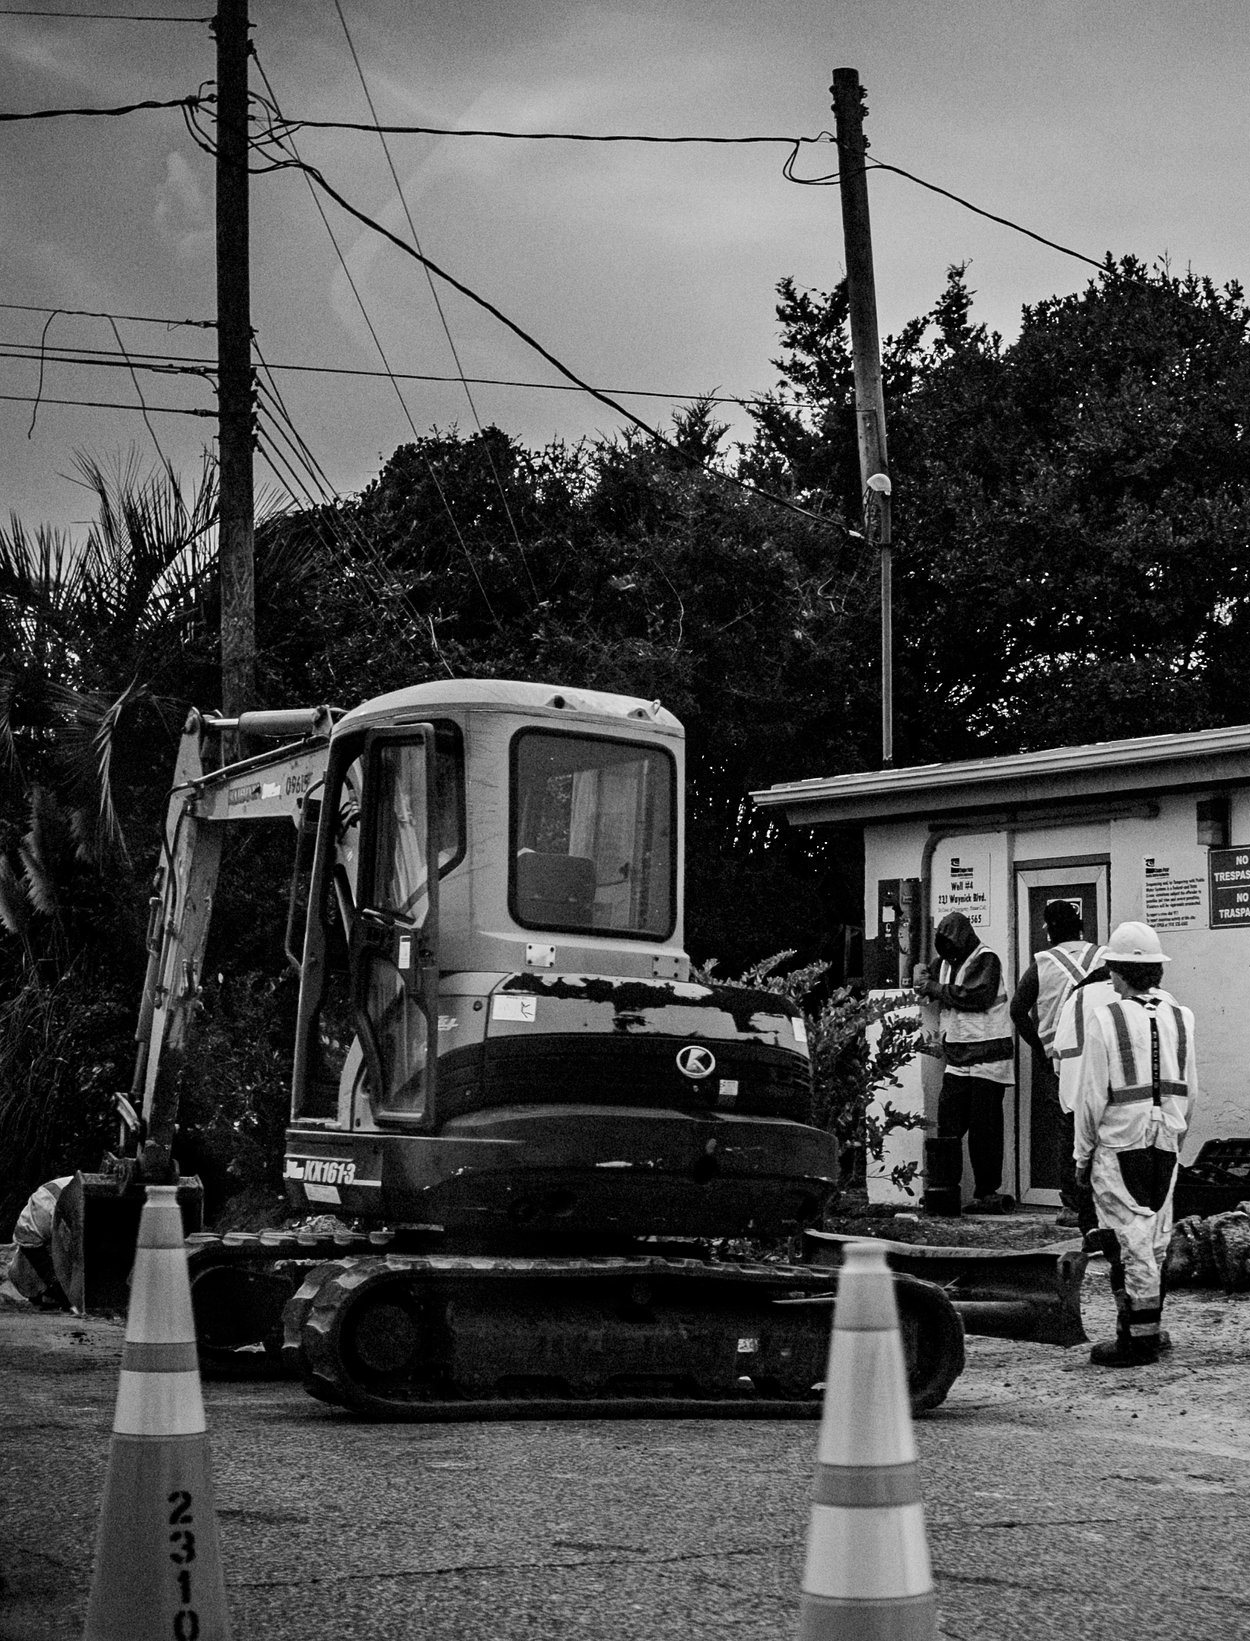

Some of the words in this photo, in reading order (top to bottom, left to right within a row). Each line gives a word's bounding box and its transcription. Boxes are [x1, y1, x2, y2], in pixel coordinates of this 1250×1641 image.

[1236, 855, 1249, 866] NO
[950, 881, 964, 891] Well
[1236, 893, 1249, 903] NO
[167, 1490, 199, 1641] 2310
